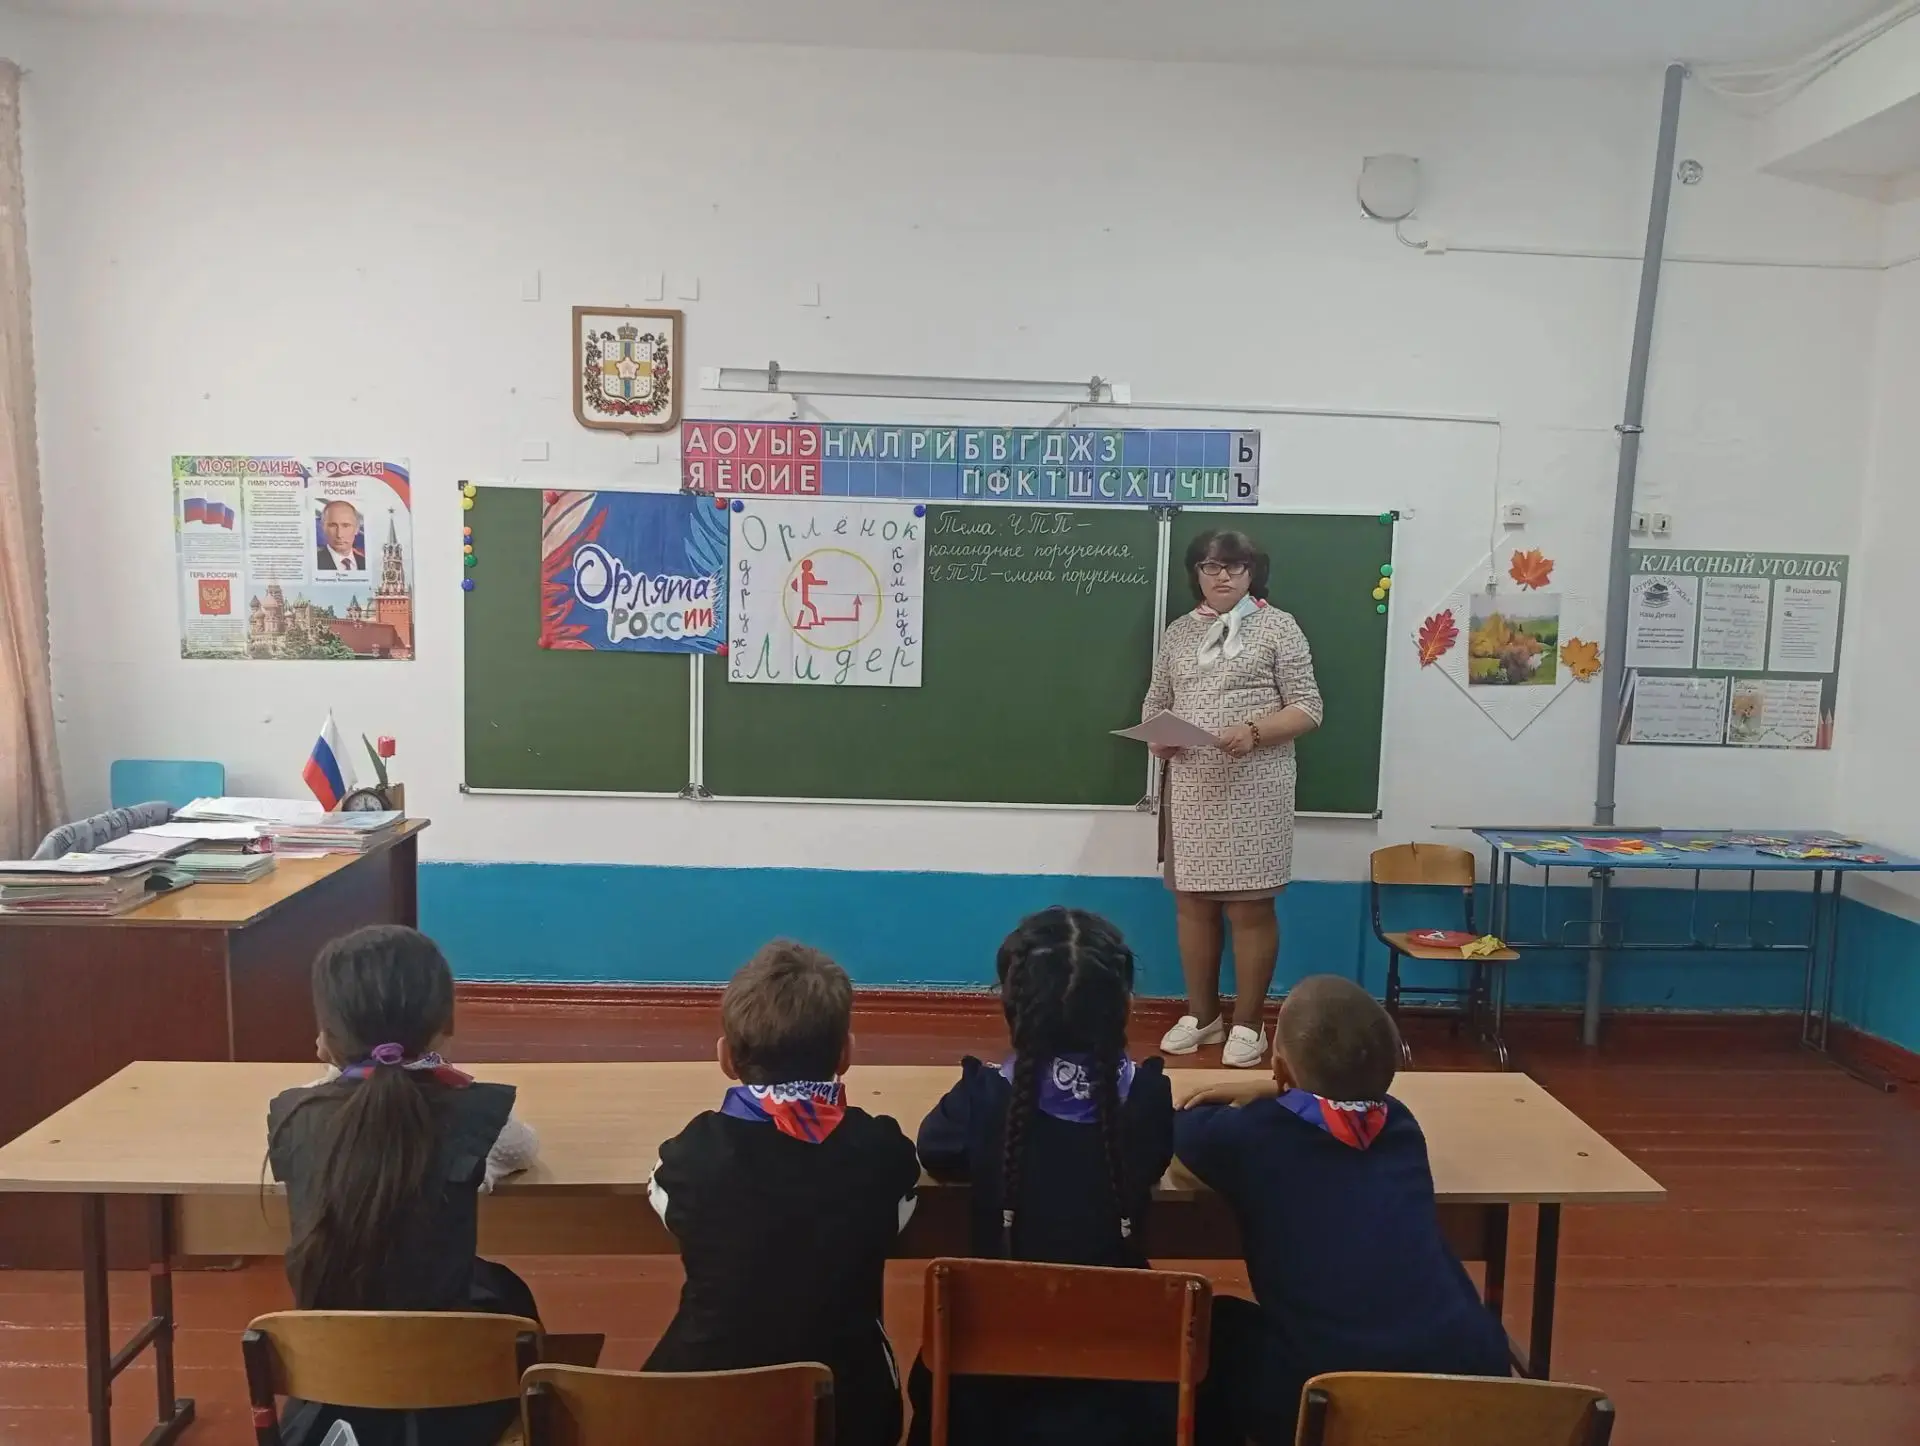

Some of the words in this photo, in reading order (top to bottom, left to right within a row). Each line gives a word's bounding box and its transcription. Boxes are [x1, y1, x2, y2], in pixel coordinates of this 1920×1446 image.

[685, 427, 708, 453] А
[713, 427, 737, 454] О
[743, 429, 762, 456] У
[770, 429, 791, 456] Ы
[799, 430, 817, 456] Э
[825, 430, 844, 457] Н
[851, 431, 874, 457] М
[879, 431, 899, 458] Л
[911, 432, 926, 458] Р
[936, 428, 955, 459] Й
[965, 434, 980, 460] Б
[992, 435, 1006, 461] В
[1020, 435, 1034, 460] Г
[1042, 436, 1063, 464] Д
[1069, 435, 1093, 462] Ж
[1100, 435, 1116, 462] З
[1238, 437, 1253, 463] Ь
[197, 460, 232, 473] МОЯ
[238, 460, 301, 474] РОДИНА
[316, 461, 383, 474] РОССИЯ
[689, 462, 704, 488] Я
[718, 459, 732, 489] Ё
[742, 463, 765, 491] Ю
[770, 464, 790, 491] И
[801, 465, 815, 491] Е
[963, 470, 980, 494] П
[987, 468, 1009, 495] Ф
[1017, 470, 1034, 496] К
[1046, 471, 1061, 496] Т
[1069, 471, 1092, 497] Ш
[1100, 471, 1115, 497] С
[1125, 471, 1145, 497] Х
[1153, 471, 1172, 500] Ц
[1181, 472, 1197, 497] Ч
[1204, 472, 1228, 501] Щ
[1234, 473, 1251, 497] Ъ
[928, 543, 1025, 564] командные
[1639, 553, 1755, 574] КЛАССНЫЙ
[1758, 558, 1842, 577] УГОЛОК
